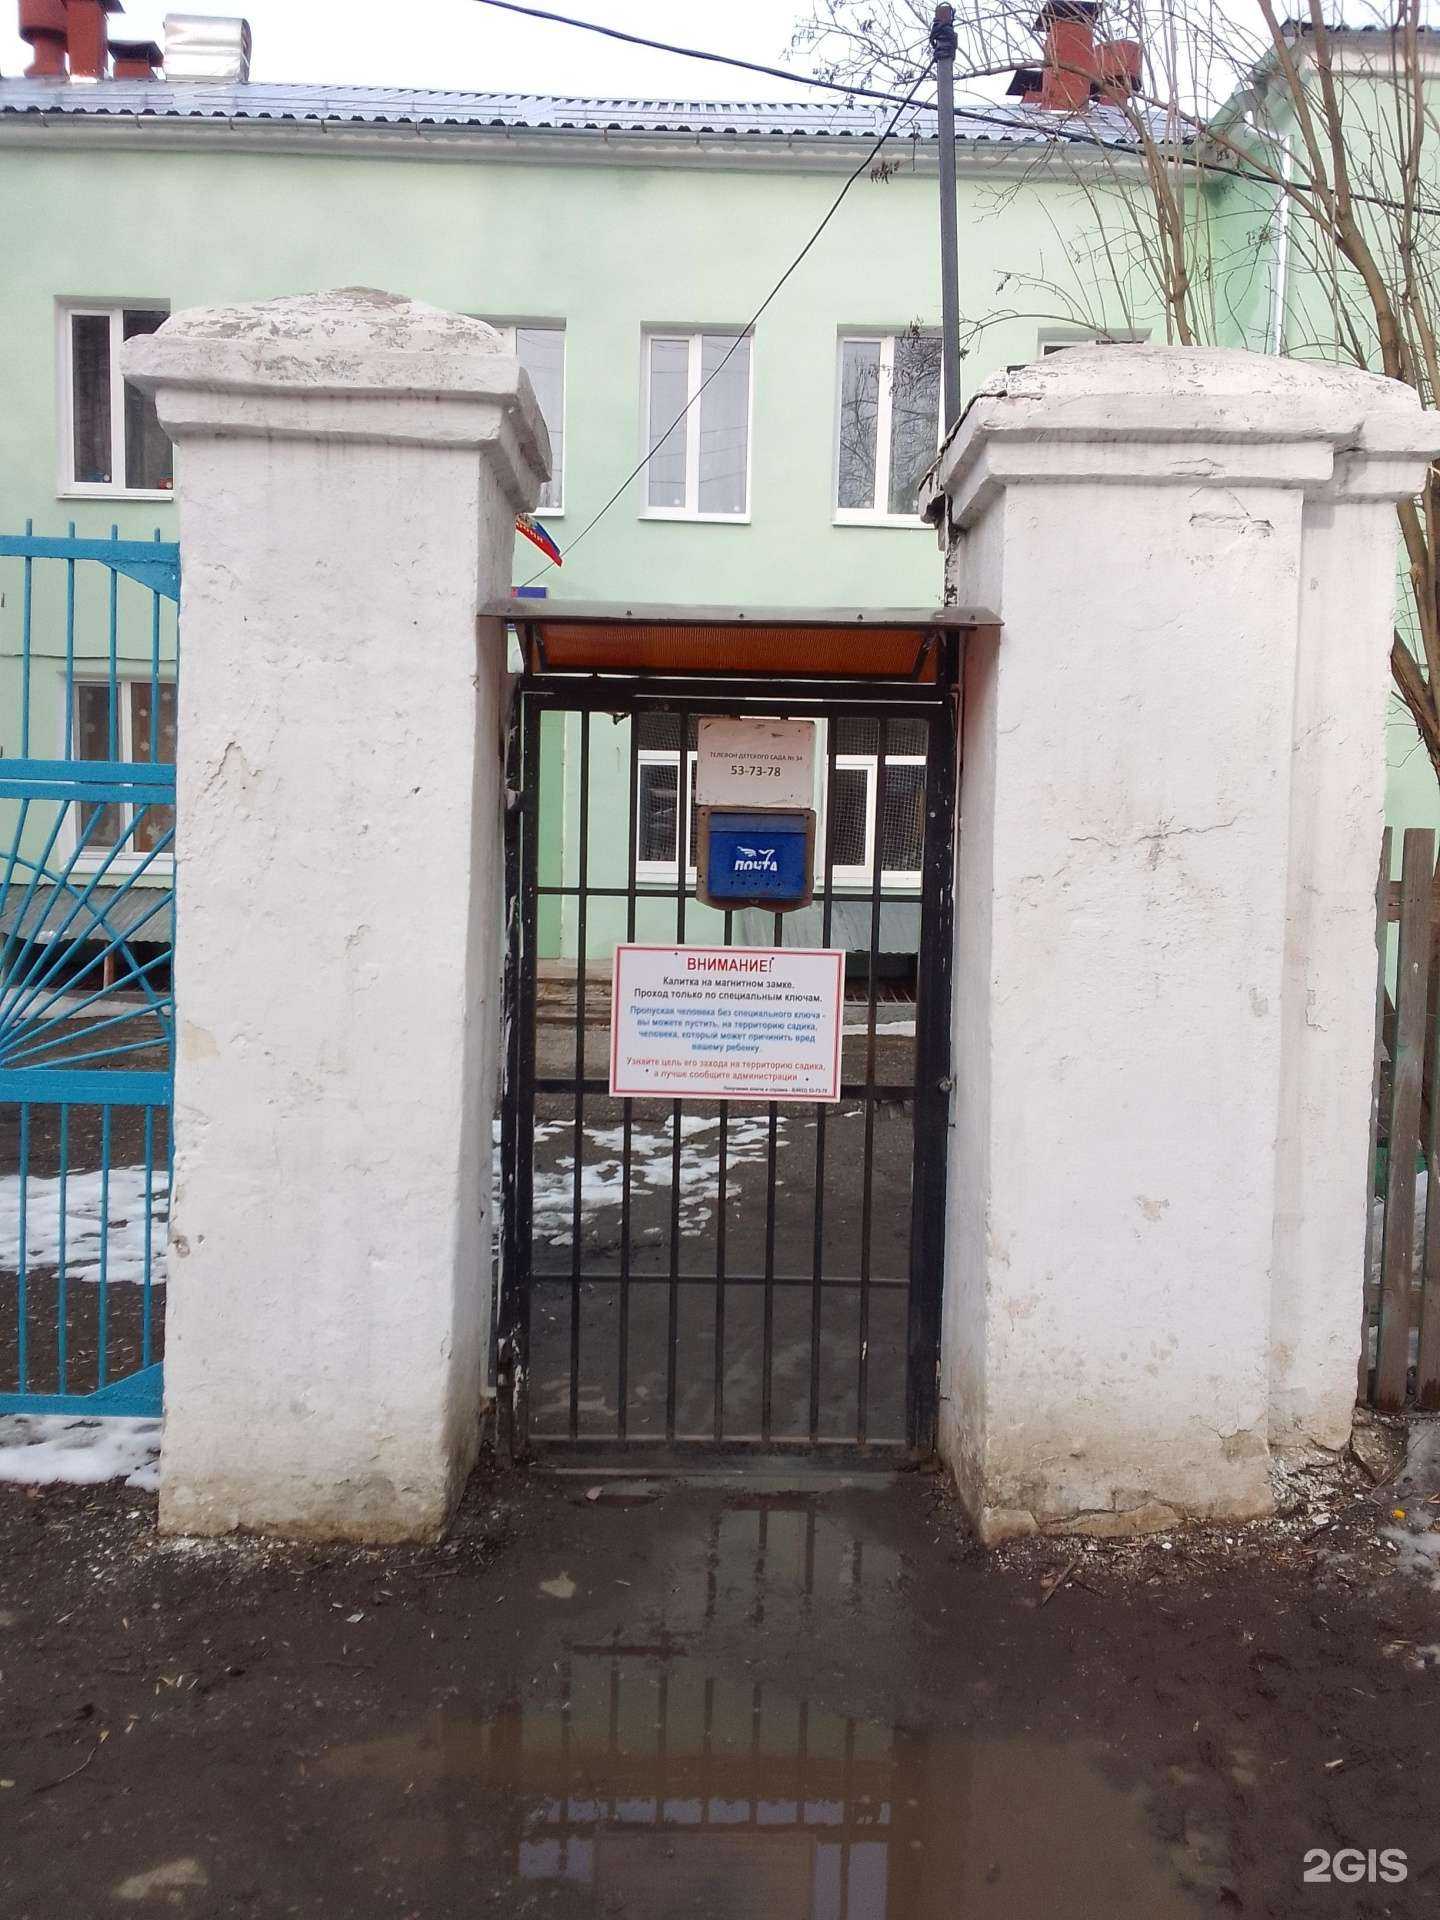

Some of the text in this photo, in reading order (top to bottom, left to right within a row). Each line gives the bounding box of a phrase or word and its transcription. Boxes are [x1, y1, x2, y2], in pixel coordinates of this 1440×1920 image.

[731, 765, 781, 776] 53-73-78
[687, 957, 773, 972] ВНИМАНИЕ!
[663, 977, 795, 989] Калитка на магнитном замке.
[634, 988, 668, 1000] Проход
[671, 991, 703, 999] только
[718, 992, 782, 1002] специальным
[785, 994, 822, 1002] ключам.
[630, 1006, 675, 1015] Пропуская
[718, 1007, 731, 1016] без
[734, 1010, 793, 1019] специального
[795, 1011, 821, 1019] ключа
[652, 1019, 682, 1027] можете
[735, 1022, 785, 1031] территорию
[681, 1031, 718, 1040] который
[720, 1031, 746, 1039] может
[749, 1033, 793, 1042] причинить
[795, 1034, 816, 1043] вред
[692, 1043, 725, 1052] вашему
[627, 1057, 659, 1065] Узнайте
[661, 1059, 681, 1067] цель
[700, 1060, 728, 1068] захода
[743, 1061, 793, 1070] территорию
[795, 1062, 826, 1071] садика,
[661, 1070, 687, 1079] лучше
[689, 1070, 730, 1079] сообщите
[733, 1072, 797, 1081] администрации
